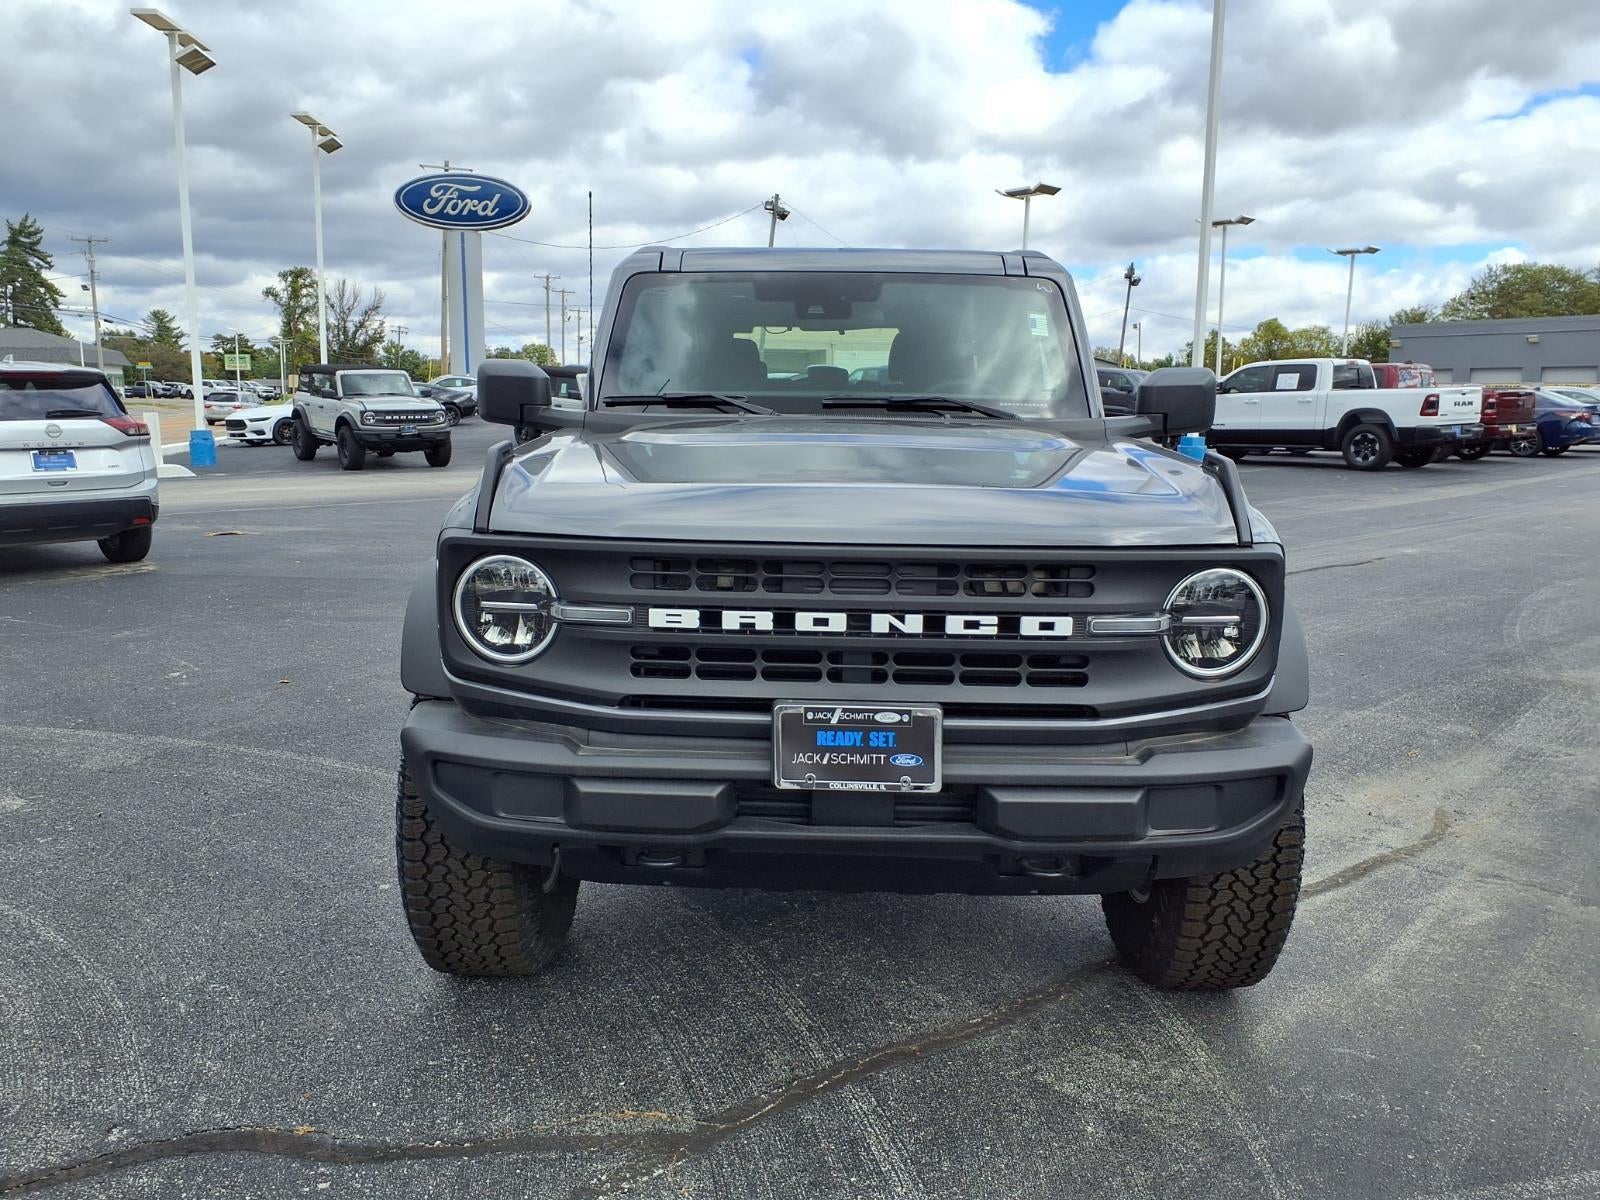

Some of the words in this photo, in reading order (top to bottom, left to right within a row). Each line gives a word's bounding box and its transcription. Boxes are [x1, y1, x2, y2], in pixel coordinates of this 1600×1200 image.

[422, 183, 501, 216] Ford
[648, 607, 1074, 637] BRONCO
[816, 730, 864, 747] READY.
[869, 731, 897, 748] SET.
